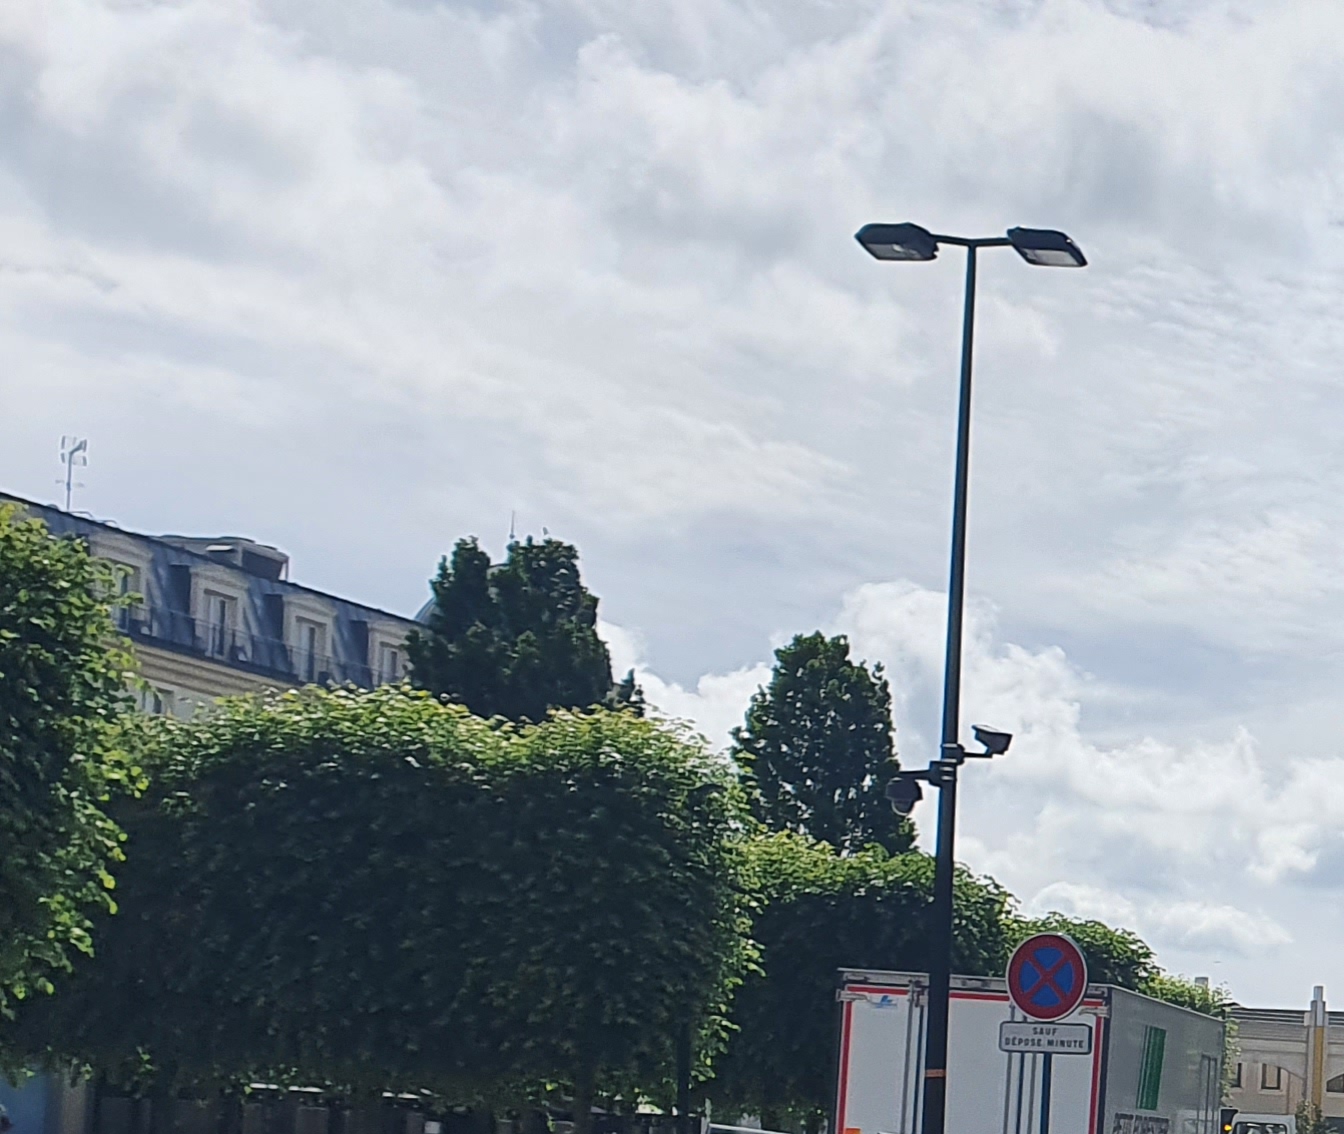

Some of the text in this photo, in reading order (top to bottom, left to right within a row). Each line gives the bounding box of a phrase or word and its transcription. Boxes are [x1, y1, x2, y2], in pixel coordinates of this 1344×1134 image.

[1032, 1026, 1058, 1036] SAUF
[1004, 1036, 1084, 1049] DÉPOSE MINUTE
